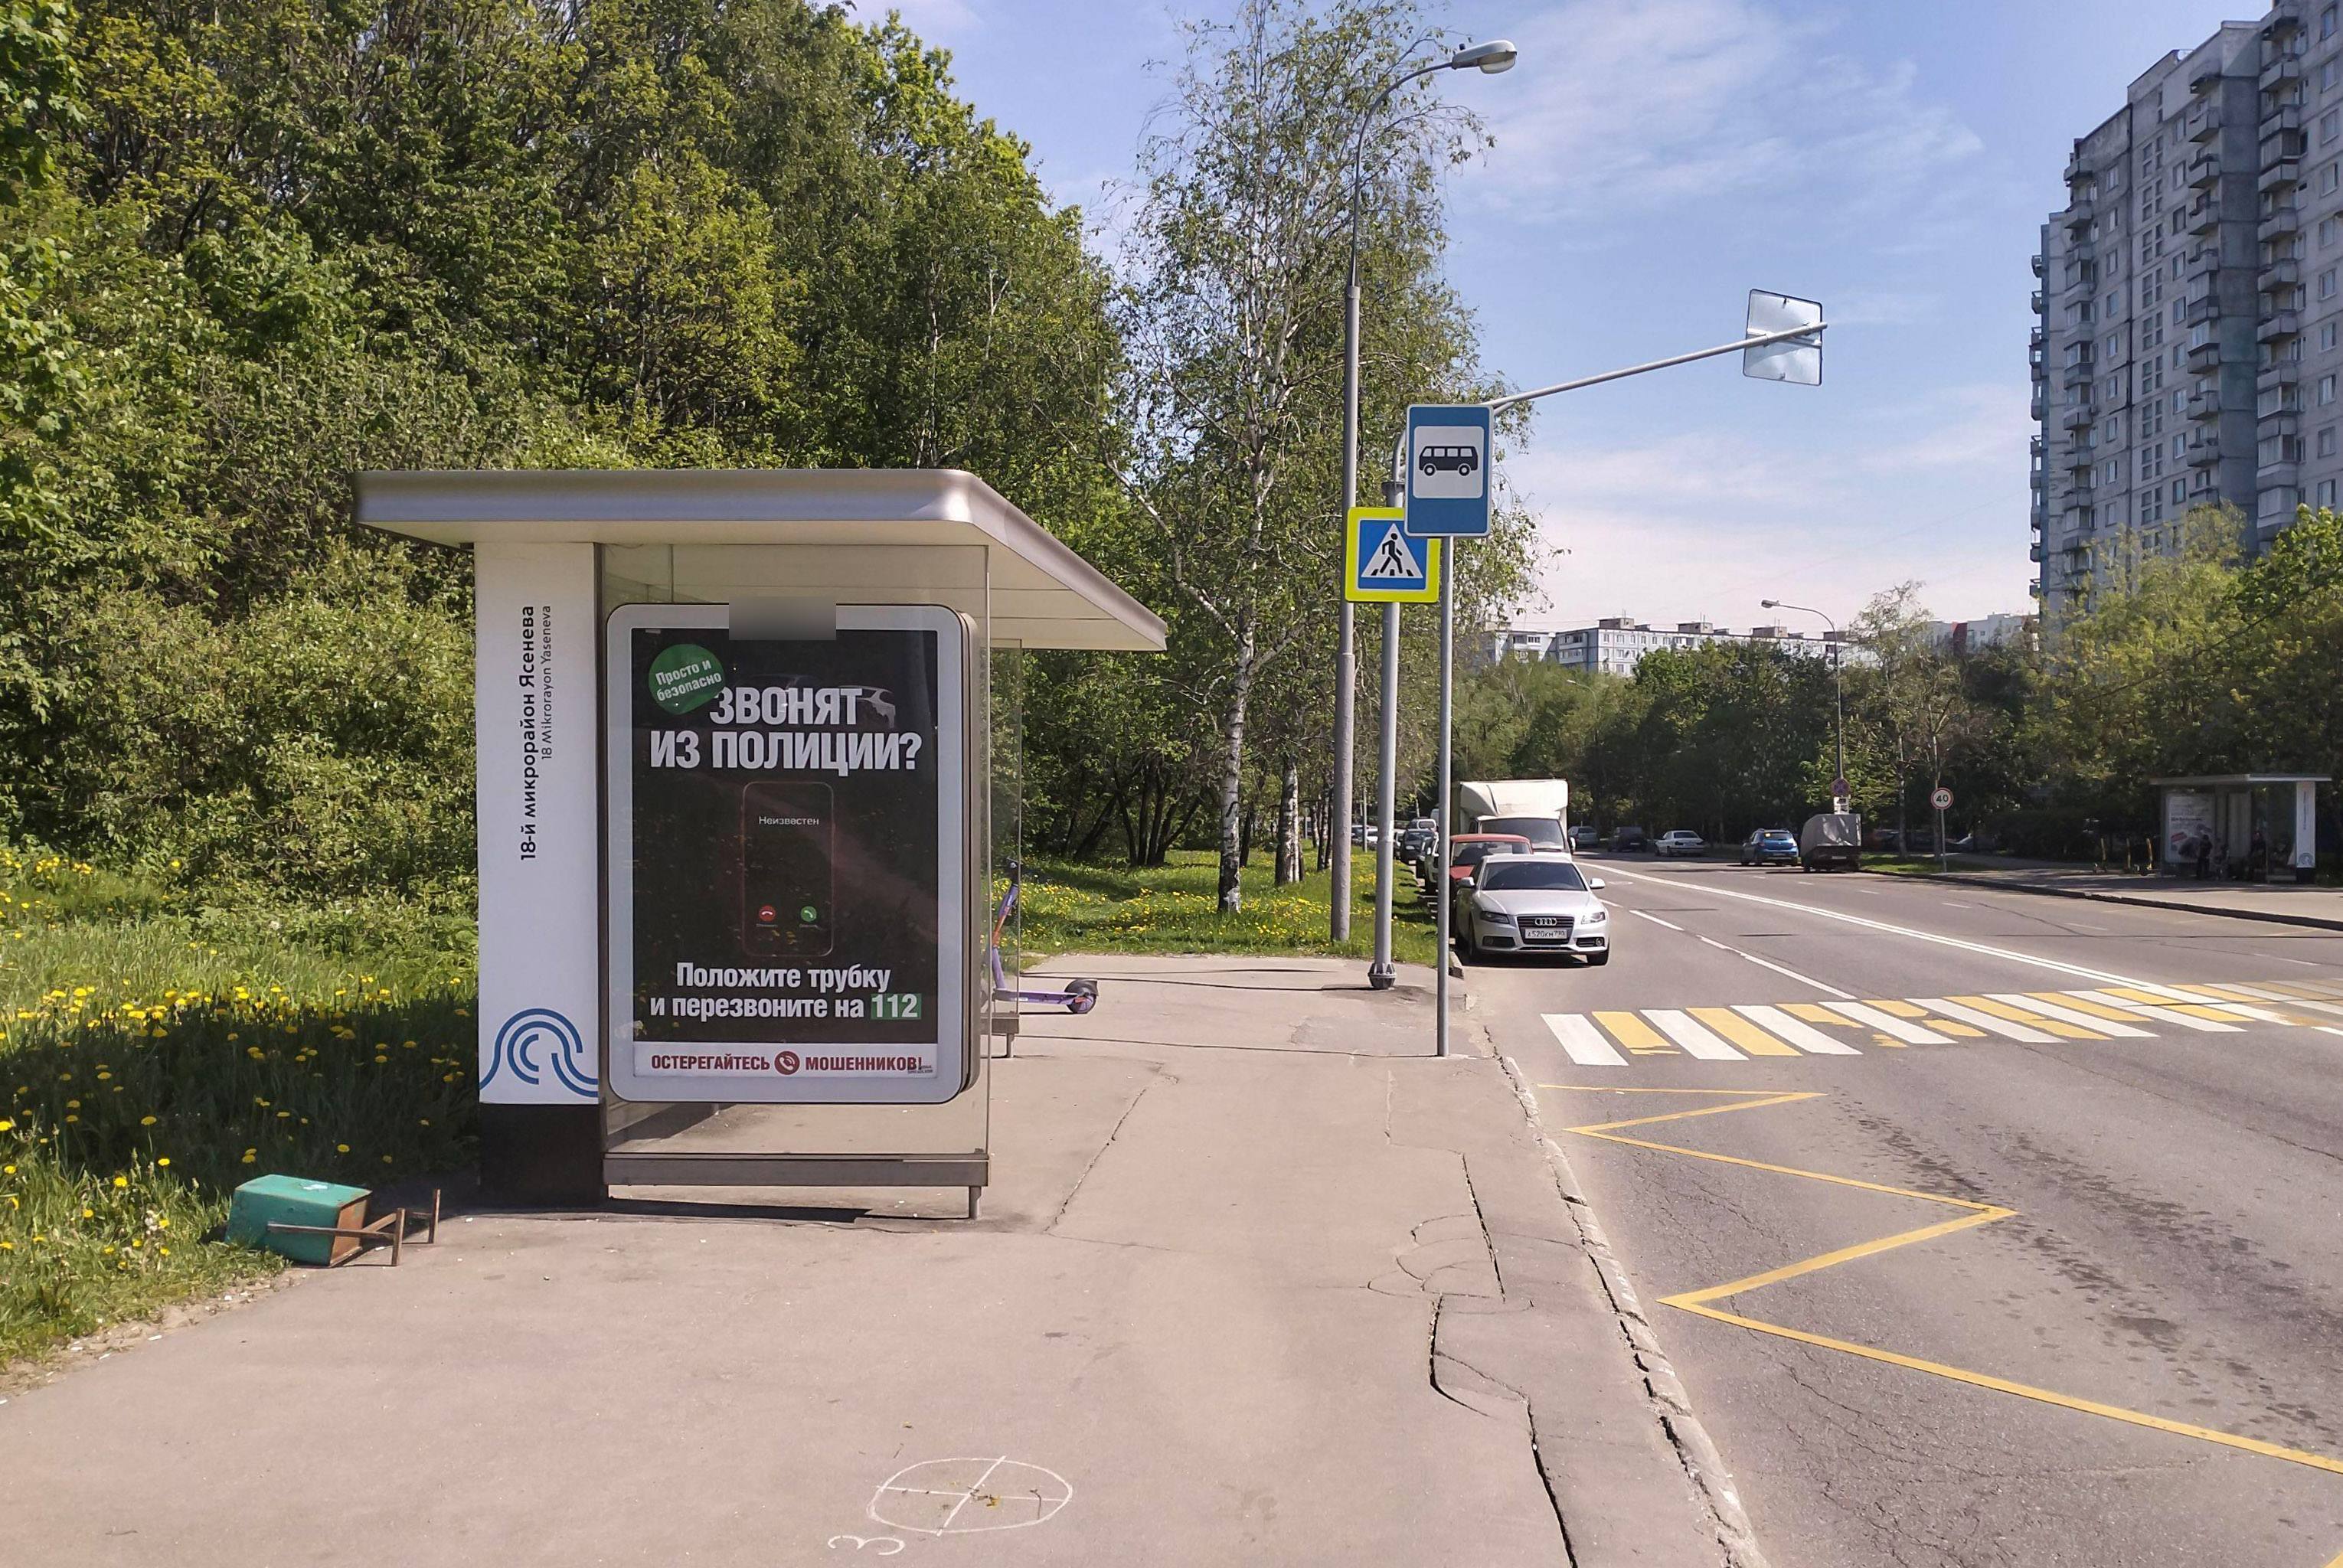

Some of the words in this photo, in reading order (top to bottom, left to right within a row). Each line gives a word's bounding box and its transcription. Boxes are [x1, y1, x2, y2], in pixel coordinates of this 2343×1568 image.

[518, 606, 535, 688] Ясенева
[541, 606, 552, 665] Yaseneva
[655, 664, 700, 685] Просто
[701, 660, 712, 671] и
[656, 673, 722, 701] безопасно
[541, 667, 555, 743] Mikrorayon
[709, 686, 862, 725] ЗВОНЯТ
[519, 694, 539, 818] микрорайон
[541, 747, 552, 760] 18
[650, 730, 700, 769] ИЗ
[712, 730, 923, 776] ПОЛИЦИИ?
[759, 816, 819, 826] Неизвестен
[520, 825, 536, 861] 18-й
[676, 962, 801, 988] Положите
[808, 964, 890, 993] трубку
[650, 998, 665, 1017] и
[672, 998, 828, 1022] перезвоните
[835, 1000, 864, 1018] на
[871, 995, 917, 1018] 112
[651, 1054, 770, 1071] ОСТЕРЕГАЙТЕСЬ
[806, 1056, 921, 1071] МОШЕННИКОВ!
